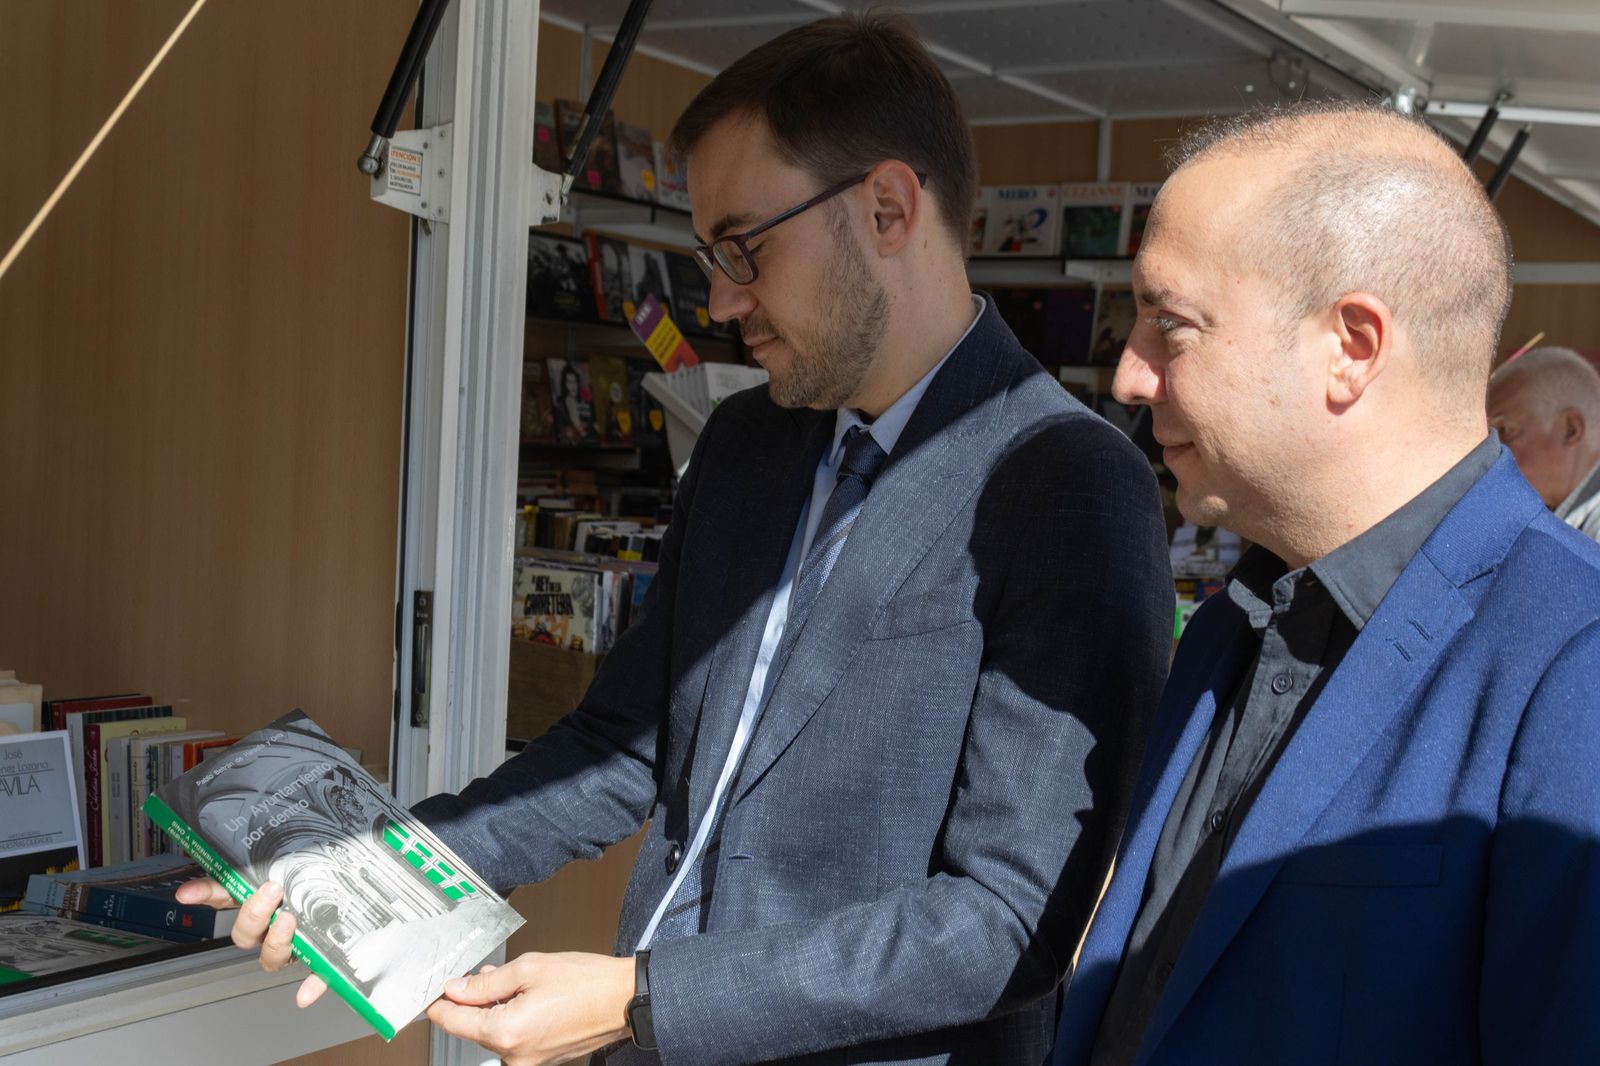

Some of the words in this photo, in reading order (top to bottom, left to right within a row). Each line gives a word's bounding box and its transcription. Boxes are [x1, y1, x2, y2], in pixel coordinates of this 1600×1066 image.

[16, 760, 49, 772] Lozano
[223, 815, 248, 832] Un
[250, 762, 332, 817] Ayuntamiento
[240, 826, 266, 850] por
[268, 799, 309, 828] dentro
[107, 894, 115, 917] PLAZA
